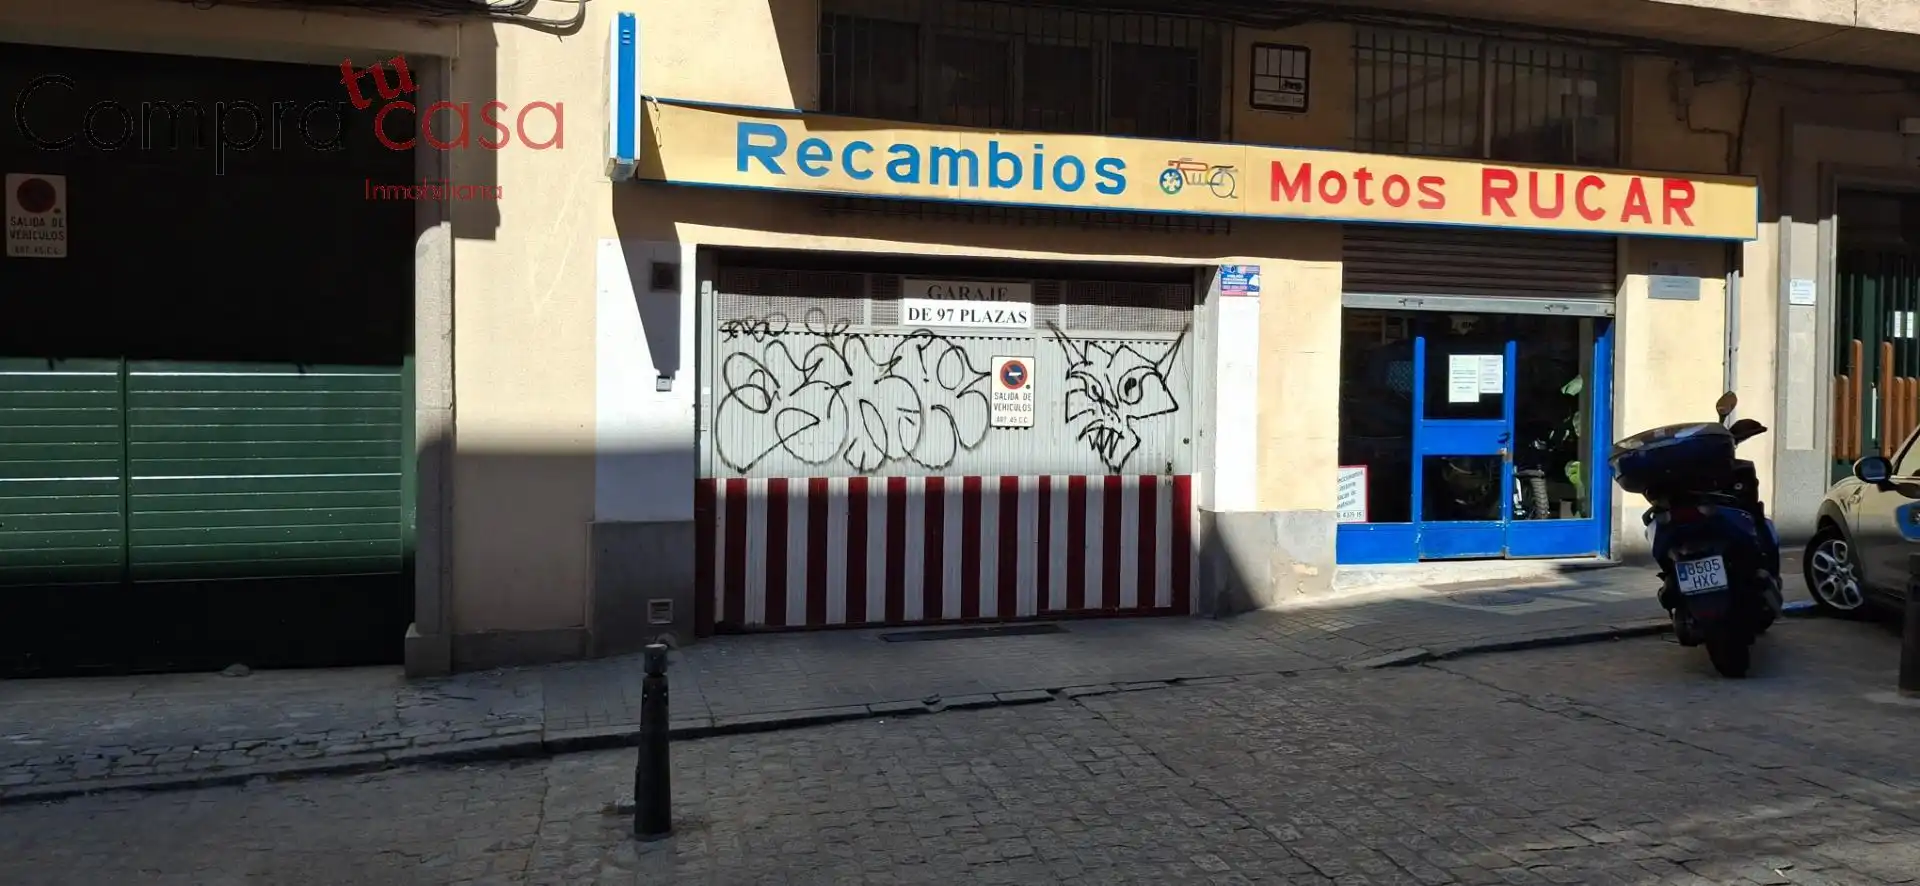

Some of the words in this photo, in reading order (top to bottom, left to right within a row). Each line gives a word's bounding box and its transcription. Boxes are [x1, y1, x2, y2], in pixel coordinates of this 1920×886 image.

[736, 121, 1127, 196] Recambios
[1270, 160, 1446, 210] Motos
[1481, 167, 1697, 227] RUCAR
[10, 216, 46, 227] SALIDA
[52, 217, 65, 227] DE
[9, 229, 65, 241] VEHICULOS
[926, 284, 1009, 301] GARAJE
[908, 307, 932, 321] DE
[937, 308, 954, 322] 97
[960, 308, 1028, 324] PLAZAS
[994, 392, 1019, 401] SALIDA
[1022, 392, 1032, 402] DE
[993, 402, 1032, 412] VEHICULOS
[1687, 558, 1721, 576] 8505
[1692, 572, 1719, 590] HXC
